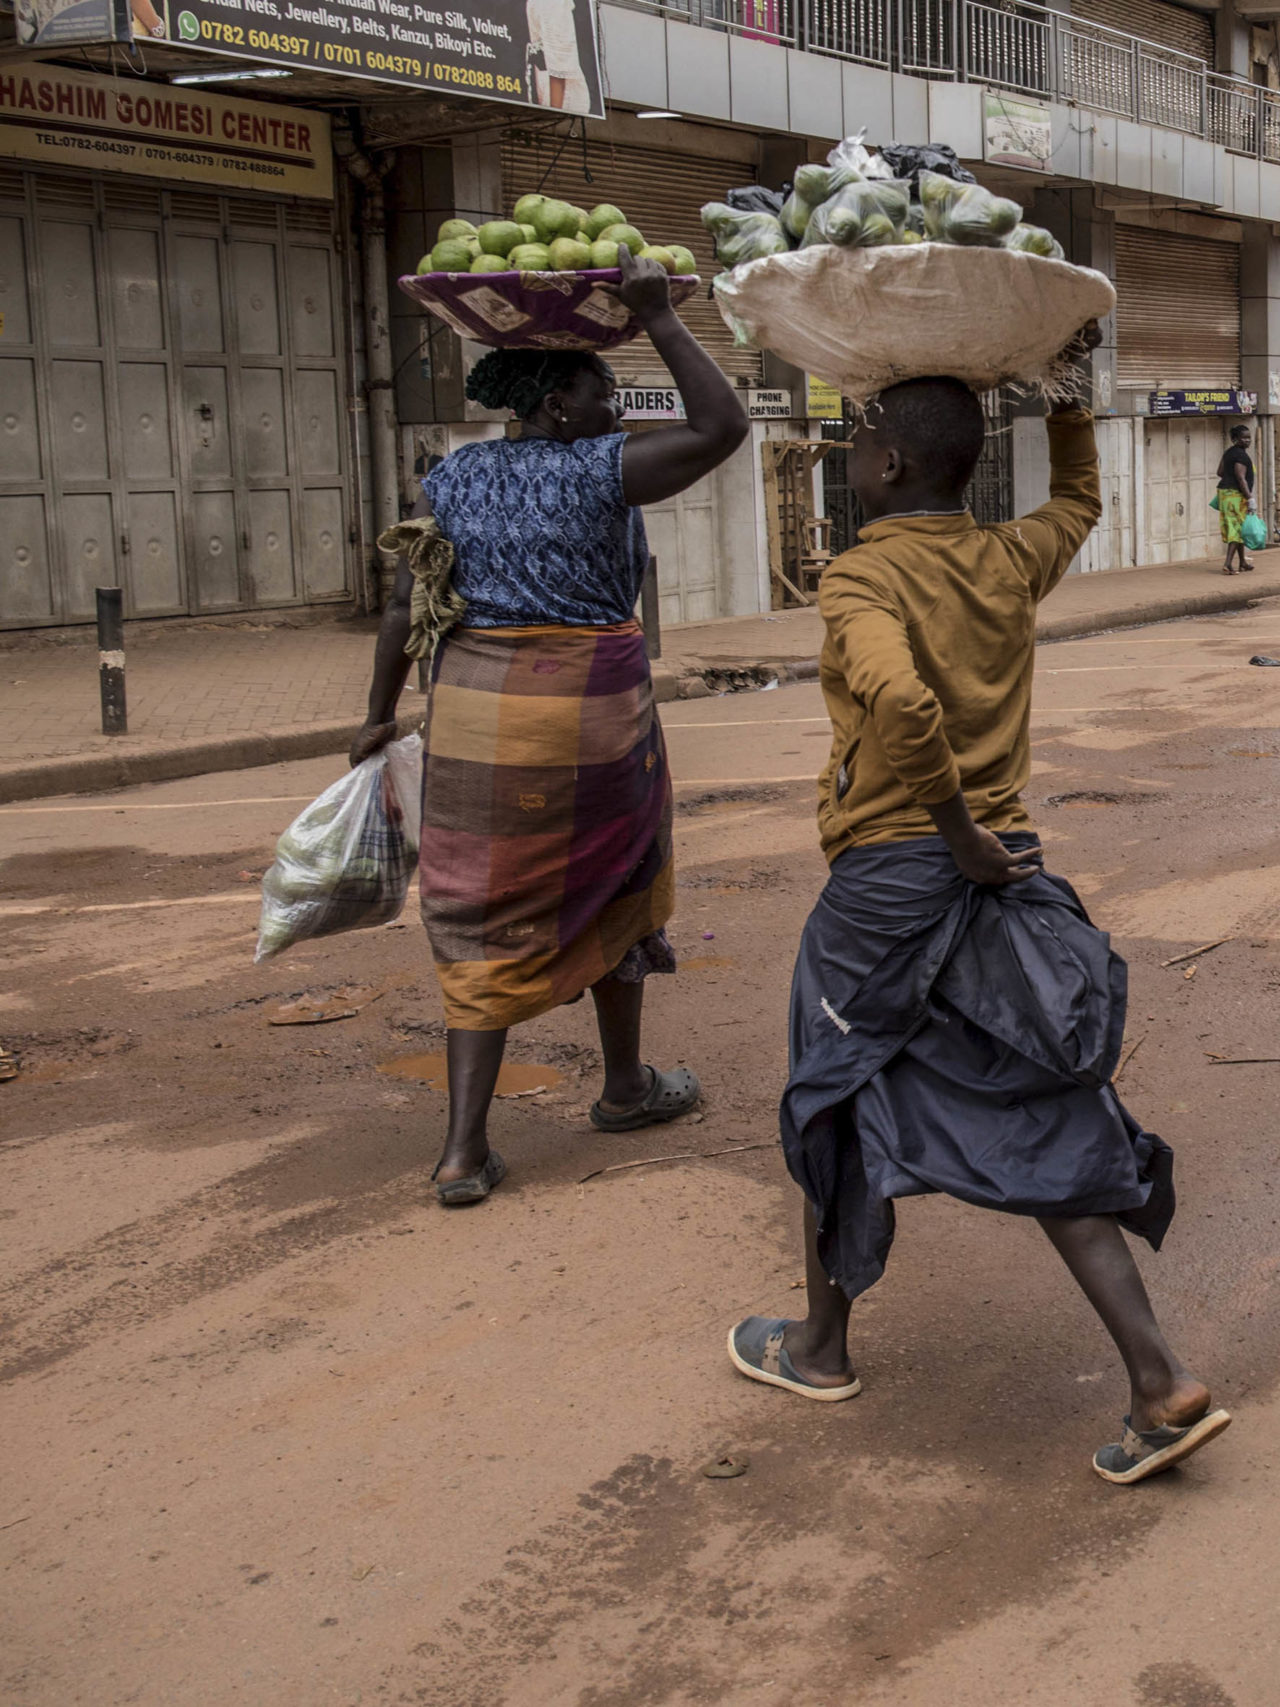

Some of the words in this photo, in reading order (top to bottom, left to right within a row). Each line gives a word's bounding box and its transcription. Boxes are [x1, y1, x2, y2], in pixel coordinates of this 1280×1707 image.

[244, 0, 281, 20] Nets,
[285, 3, 351, 34] Jewellery,
[353, 15, 390, 41] Belts,
[391, 24, 434, 49] Kanzu,
[435, 33, 472, 57] Bikoyi
[473, 42, 496, 59] Etc.
[379, 0, 412, 21] Wear,
[414, 5, 443, 25] Pure
[445, 12, 471, 34] Silk,
[472, 17, 512, 42] Volvet,
[201, 20, 246, 46] 0782
[249, 29, 310, 57] 604397
[314, 41, 320, 59] /
[324, 43, 362, 66] 0701
[366, 51, 422, 76] 604379
[425, 62, 431, 79] /
[434, 63, 494, 89] 0782088
[497, 75, 523, 94] 864
[0, 73, 106, 120] HASHIM
[116, 92, 213, 137] GOMESI
[221, 109, 312, 153] CENTER
[146, 149, 214, 167] 0701-604379
[614, 389, 675, 411] RADERS
[750, 405, 790, 416] CHARGING
[757, 392, 783, 403] PHONE
